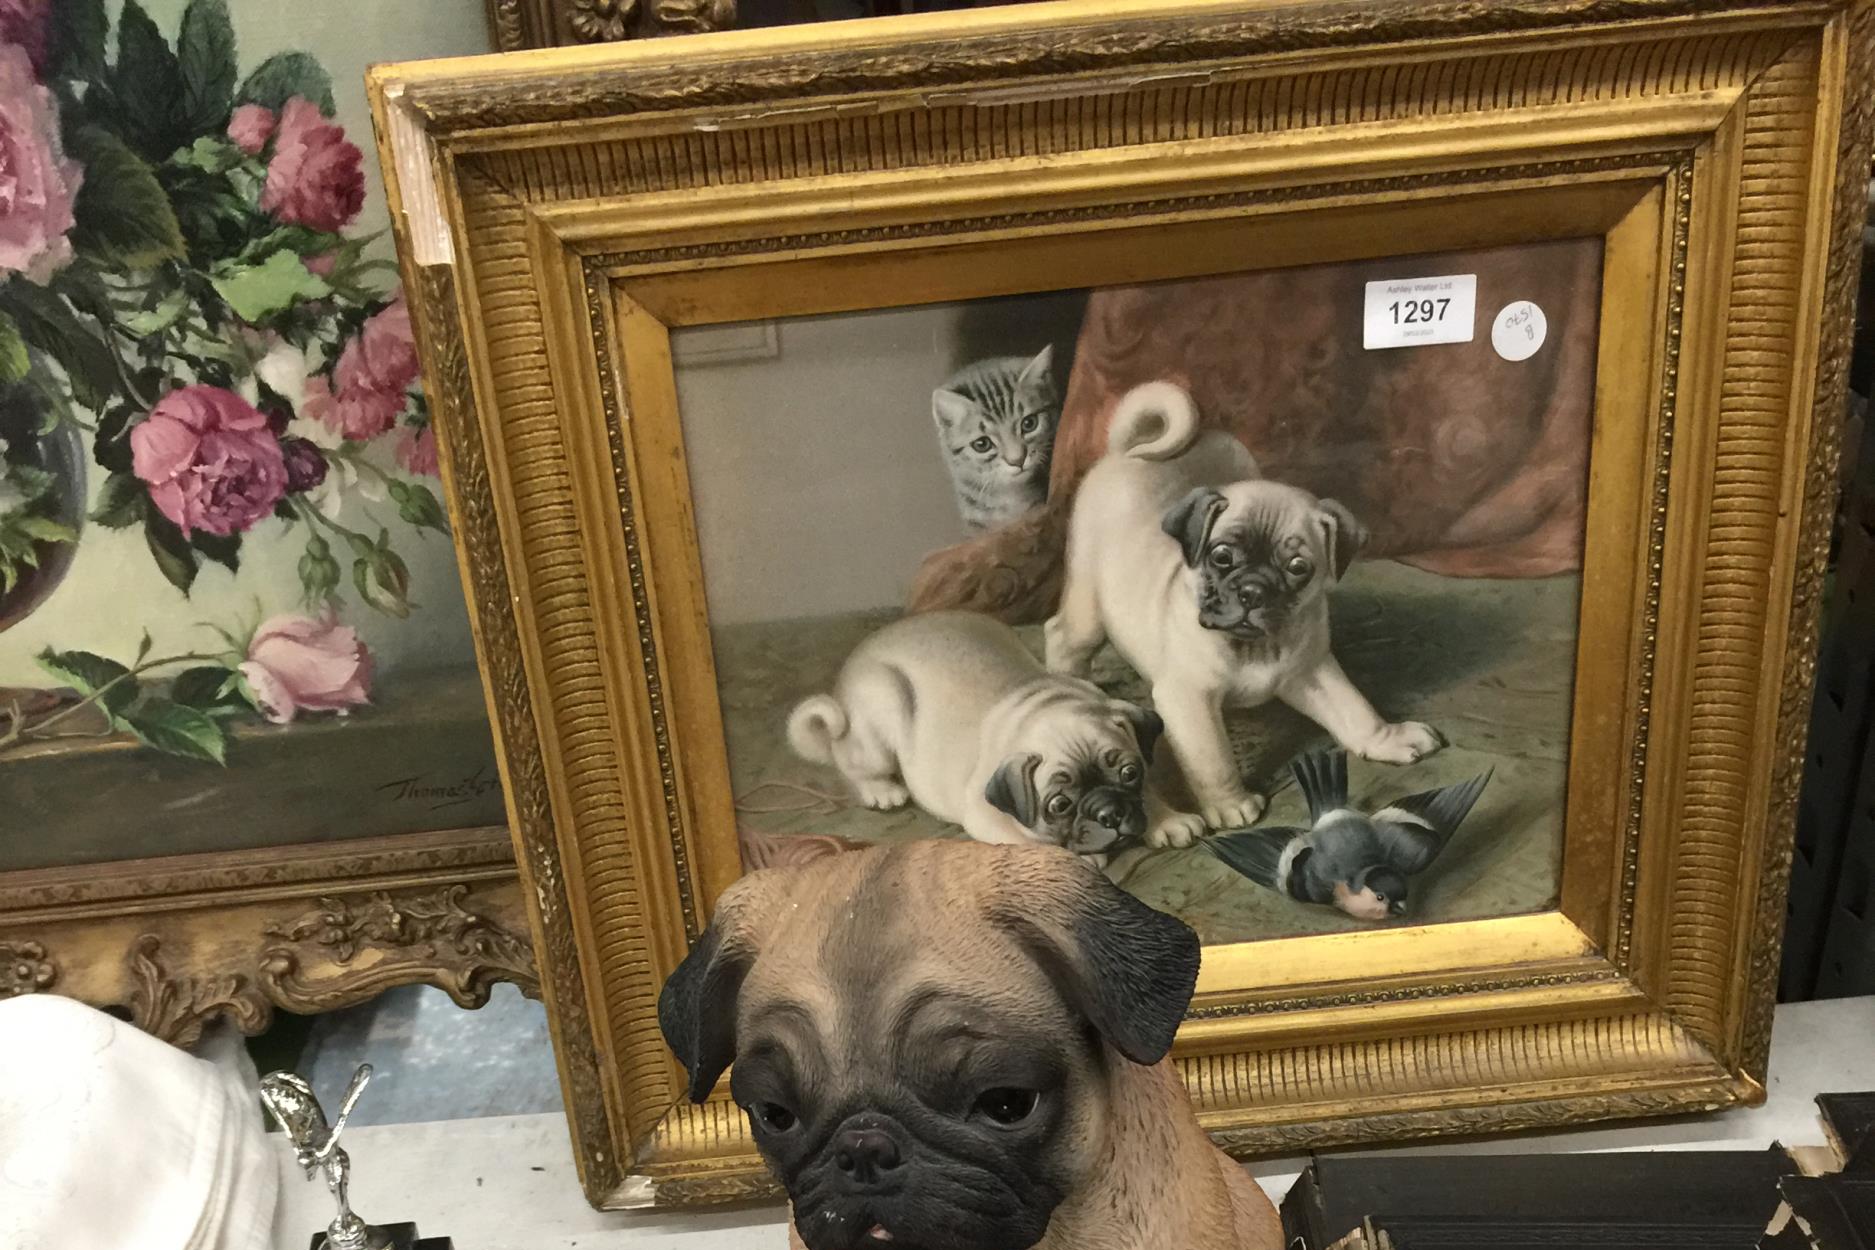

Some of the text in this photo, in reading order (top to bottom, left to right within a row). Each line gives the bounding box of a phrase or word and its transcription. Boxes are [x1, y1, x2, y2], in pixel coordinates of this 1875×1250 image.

[1387, 285, 1411, 294] Ashley
[1439, 281, 1452, 290] Ltd
[1389, 298, 1451, 324] 1297
